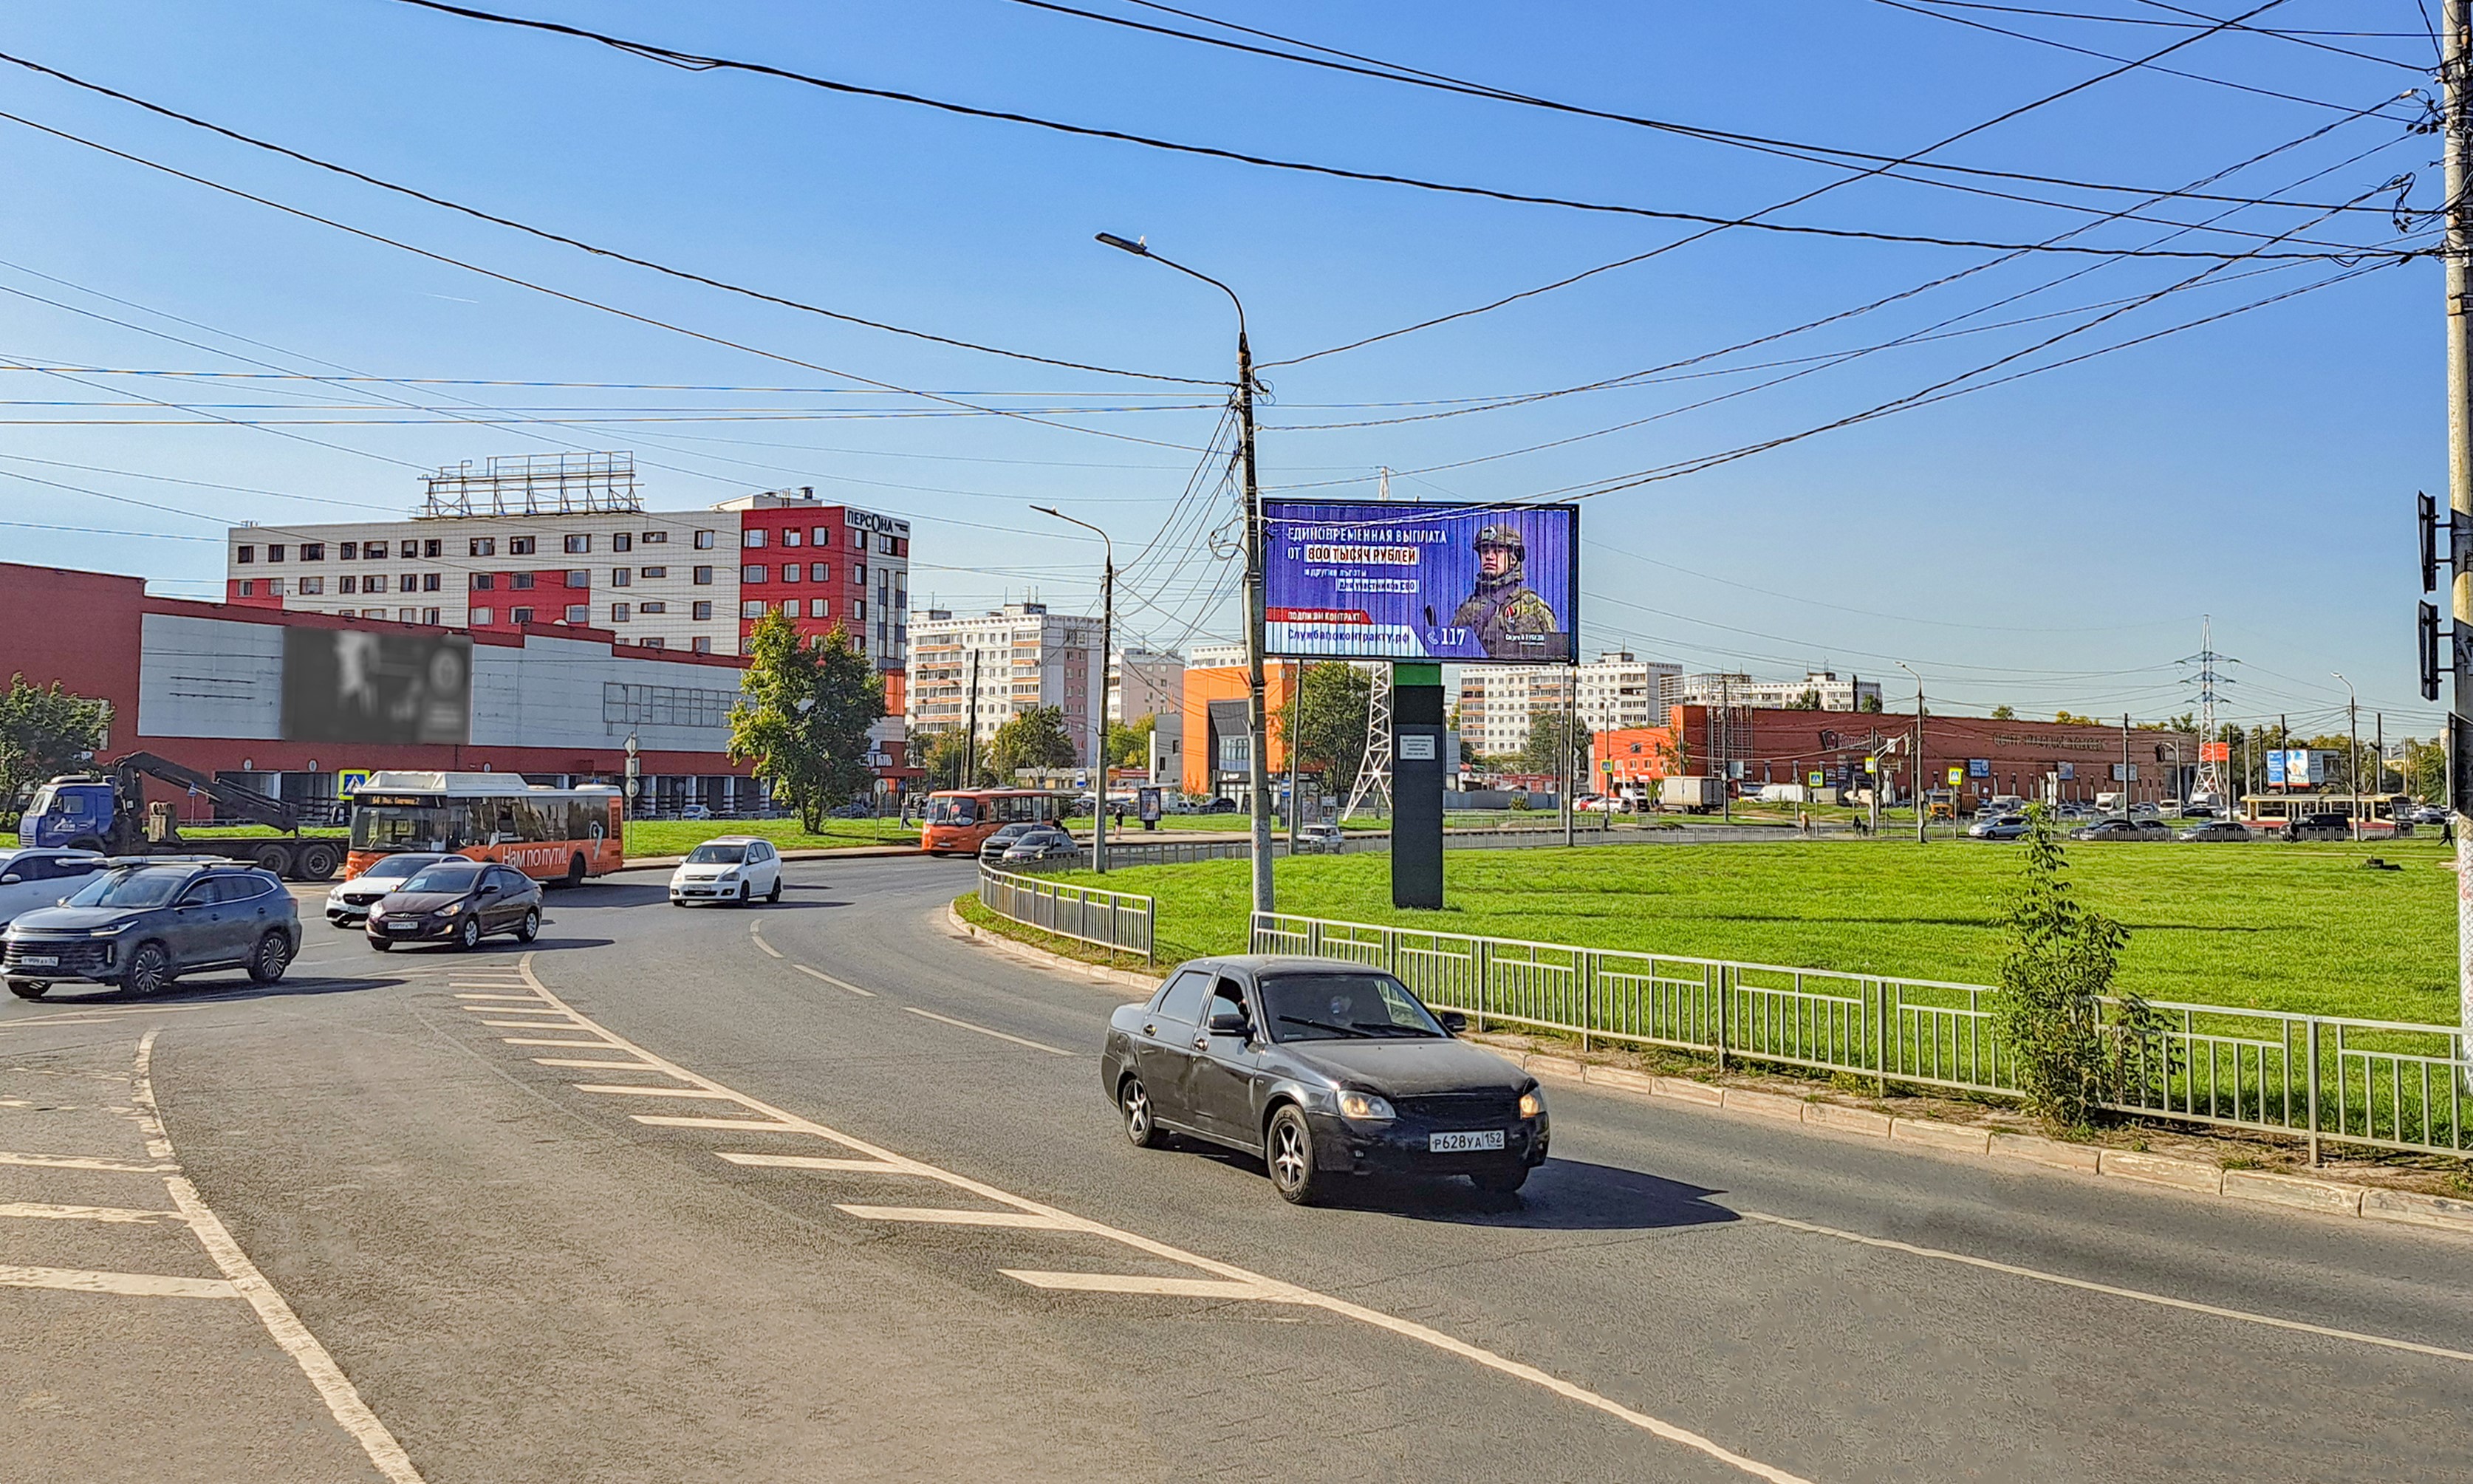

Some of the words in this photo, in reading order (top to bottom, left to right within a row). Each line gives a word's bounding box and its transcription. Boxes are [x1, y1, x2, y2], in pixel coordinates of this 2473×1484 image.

[847, 510, 893, 533] ПЕРСОНА
[1287, 527, 1393, 543] ЕДИНОВРЕМЕННАЯ
[1395, 529, 1447, 544] ВЫПЛАТА
[1287, 547, 1301, 560] ОТ
[1308, 547, 1330, 561] 800
[1333, 547, 1370, 561] ТЫСЯЧ
[1373, 546, 1415, 562] РУБЛЕЙ
[1400, 581, 1415, 590] СВО
[1324, 612, 1361, 621] КОНТРАКТ
[1441, 628, 1465, 646] 117
[502, 846, 525, 868] Нам
[527, 848, 541, 866] по
[542, 843, 567, 869] пути!
[1434, 1135, 1482, 1149] Р628УА
[1485, 1132, 1502, 1144] 152
